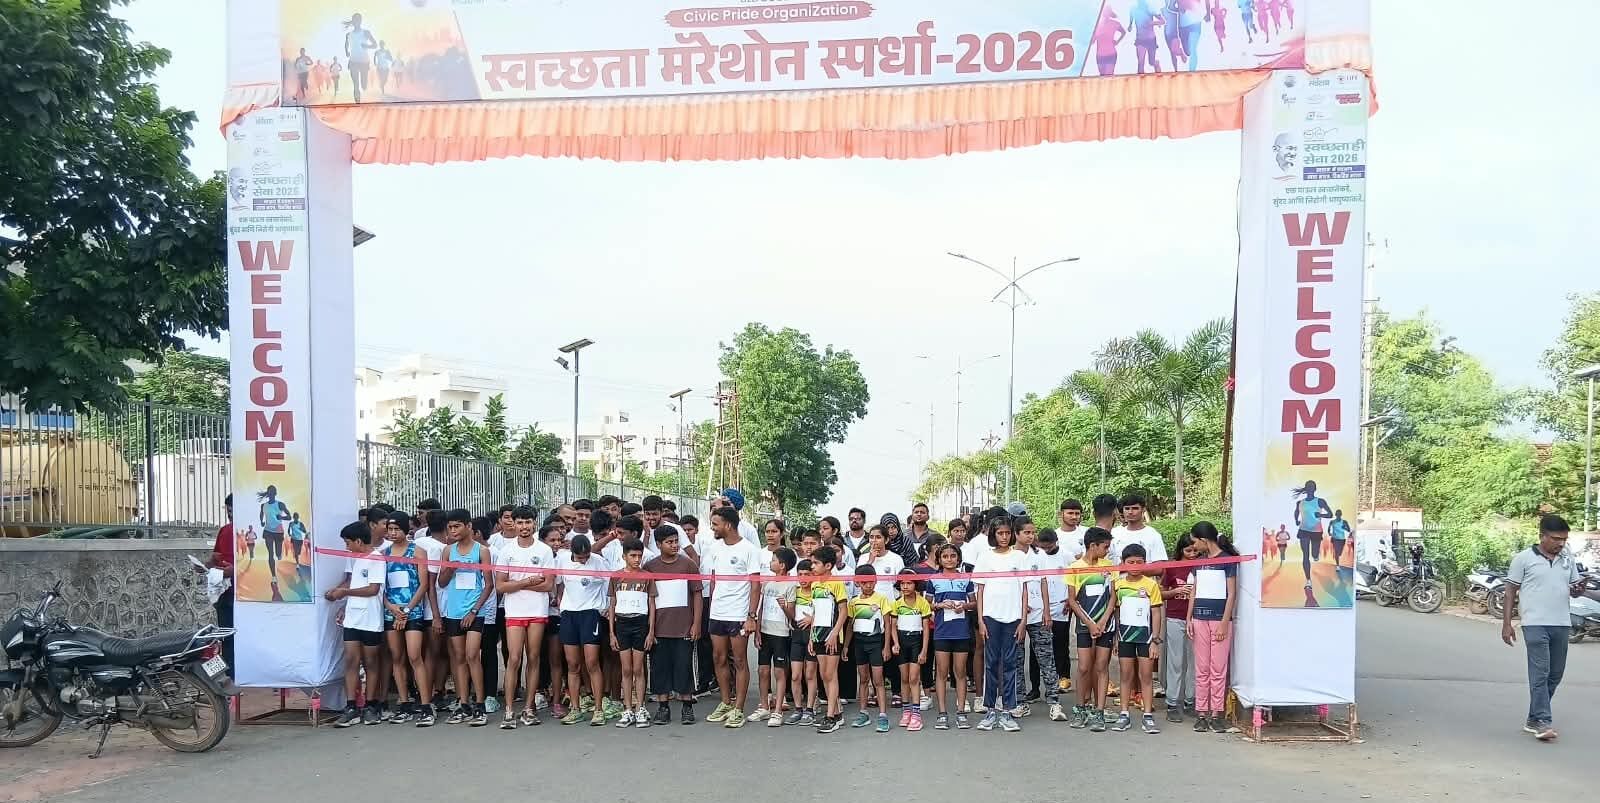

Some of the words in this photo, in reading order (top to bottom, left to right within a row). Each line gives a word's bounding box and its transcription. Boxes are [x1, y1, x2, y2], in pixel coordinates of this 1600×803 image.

[683, 11, 719, 23] Civic
[722, 8, 759, 21] Pride
[481, 48, 649, 93] स्वच्छता
[658, 31, 809, 87] मॅरेथोन
[818, 20, 1075, 80] स्पर्धा-2026
[1304, 142, 1349, 151] स्वच्छता
[1304, 153, 1329, 165] सेवा
[236, 240, 295, 472] WELCOME
[1281, 211, 1351, 466] WELCOME
